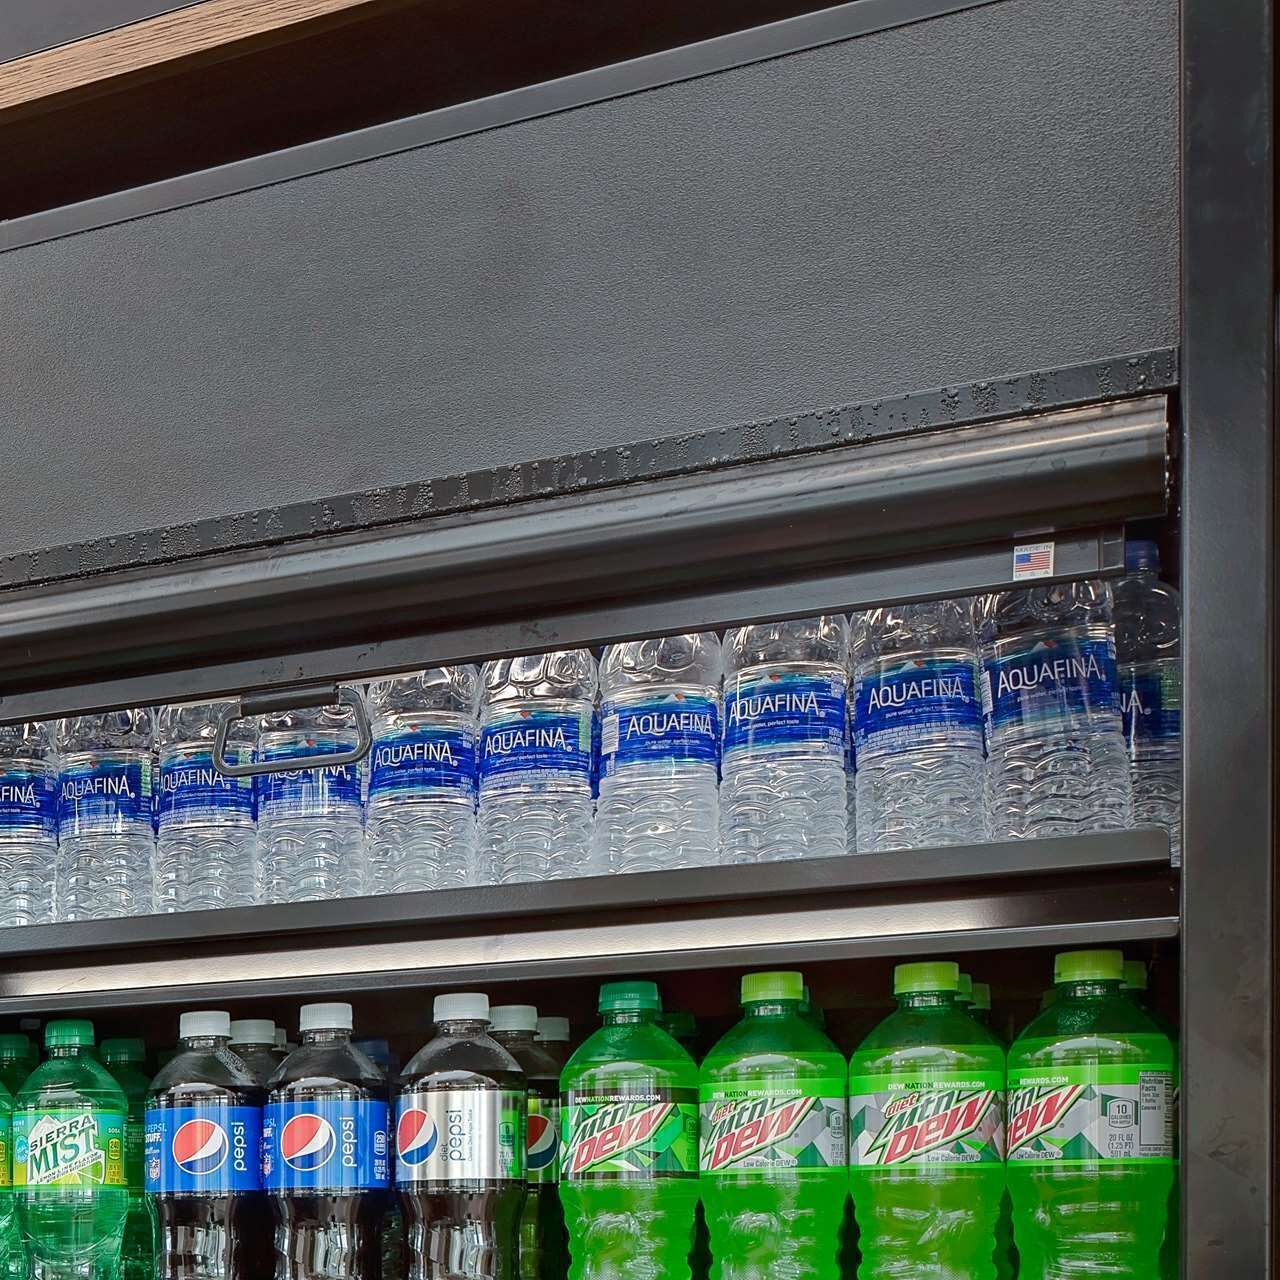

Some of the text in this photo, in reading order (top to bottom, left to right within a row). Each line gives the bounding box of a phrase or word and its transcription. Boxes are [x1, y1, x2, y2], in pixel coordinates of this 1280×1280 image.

[998, 654, 1101, 698] AQUAFINA
[729, 691, 819, 727] AQUAFINA
[868, 676, 964, 714] AQUAFINA
[485, 727, 567, 759] AQUAFINA
[627, 714, 712, 740] AQUAFINA
[374, 742, 454, 772] AQUAFINA
[61, 775, 130, 800] AQUAFINA
[160, 768, 226, 793] AQUAFINA
[575, 1094, 661, 1104] DEWNATIONREWARDS.COM
[712, 1088, 802, 1099] DEWNATIONREWARDS.COM
[887, 1080, 986, 1090] DEWNATIONREWARDS.COM
[1116, 1104, 1128, 1115] 10
[30, 1115, 93, 1152] SIERRA
[231, 1121, 247, 1172] pepsi
[339, 1116, 357, 1168] pepsi
[440, 1109, 466, 1162] diet pepsi
[29, 1124, 96, 1183] MIST
